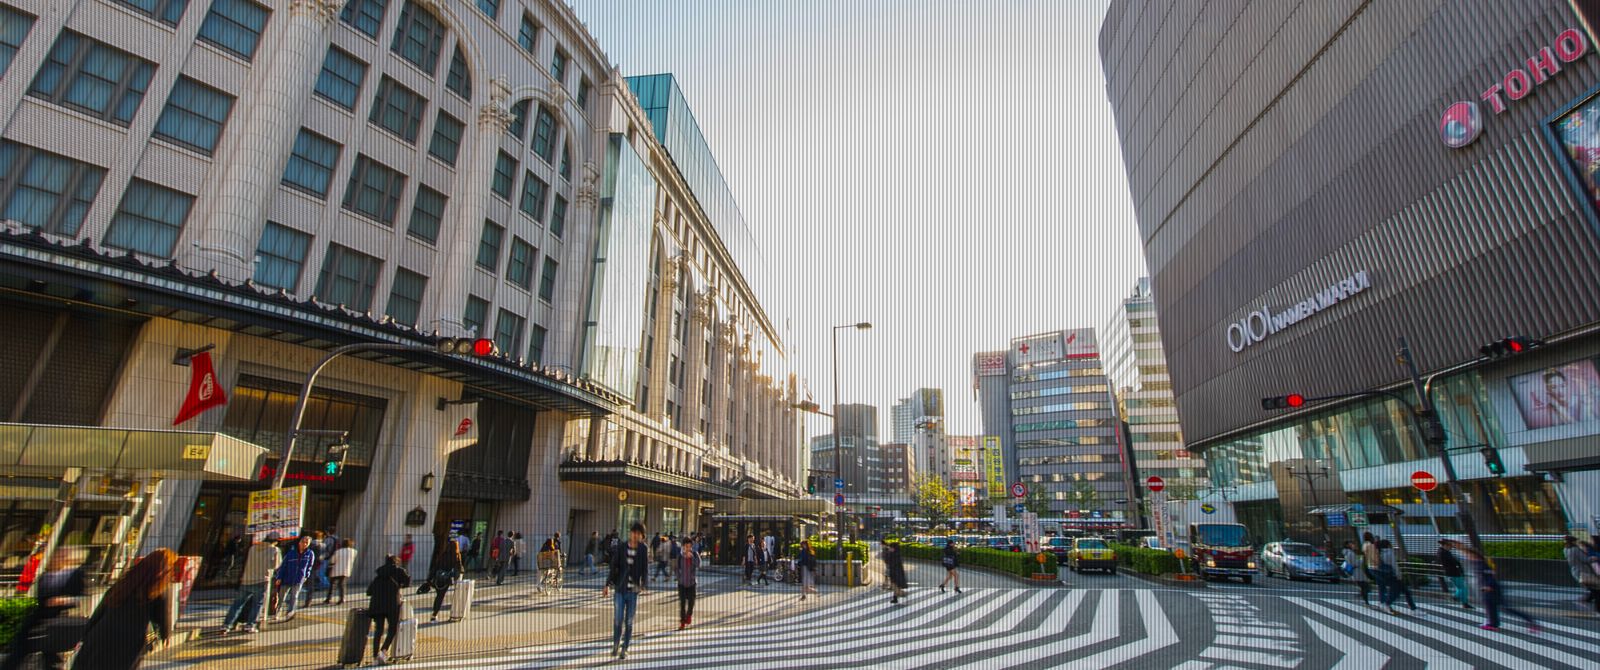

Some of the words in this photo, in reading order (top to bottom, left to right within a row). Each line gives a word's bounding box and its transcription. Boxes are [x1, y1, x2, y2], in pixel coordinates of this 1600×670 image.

[1480, 28, 1588, 114] TOHO
[255, 346, 400, 383] TAKAHIMAYA
[979, 355, 1003, 366] ECC
[189, 448, 204, 456] E4
